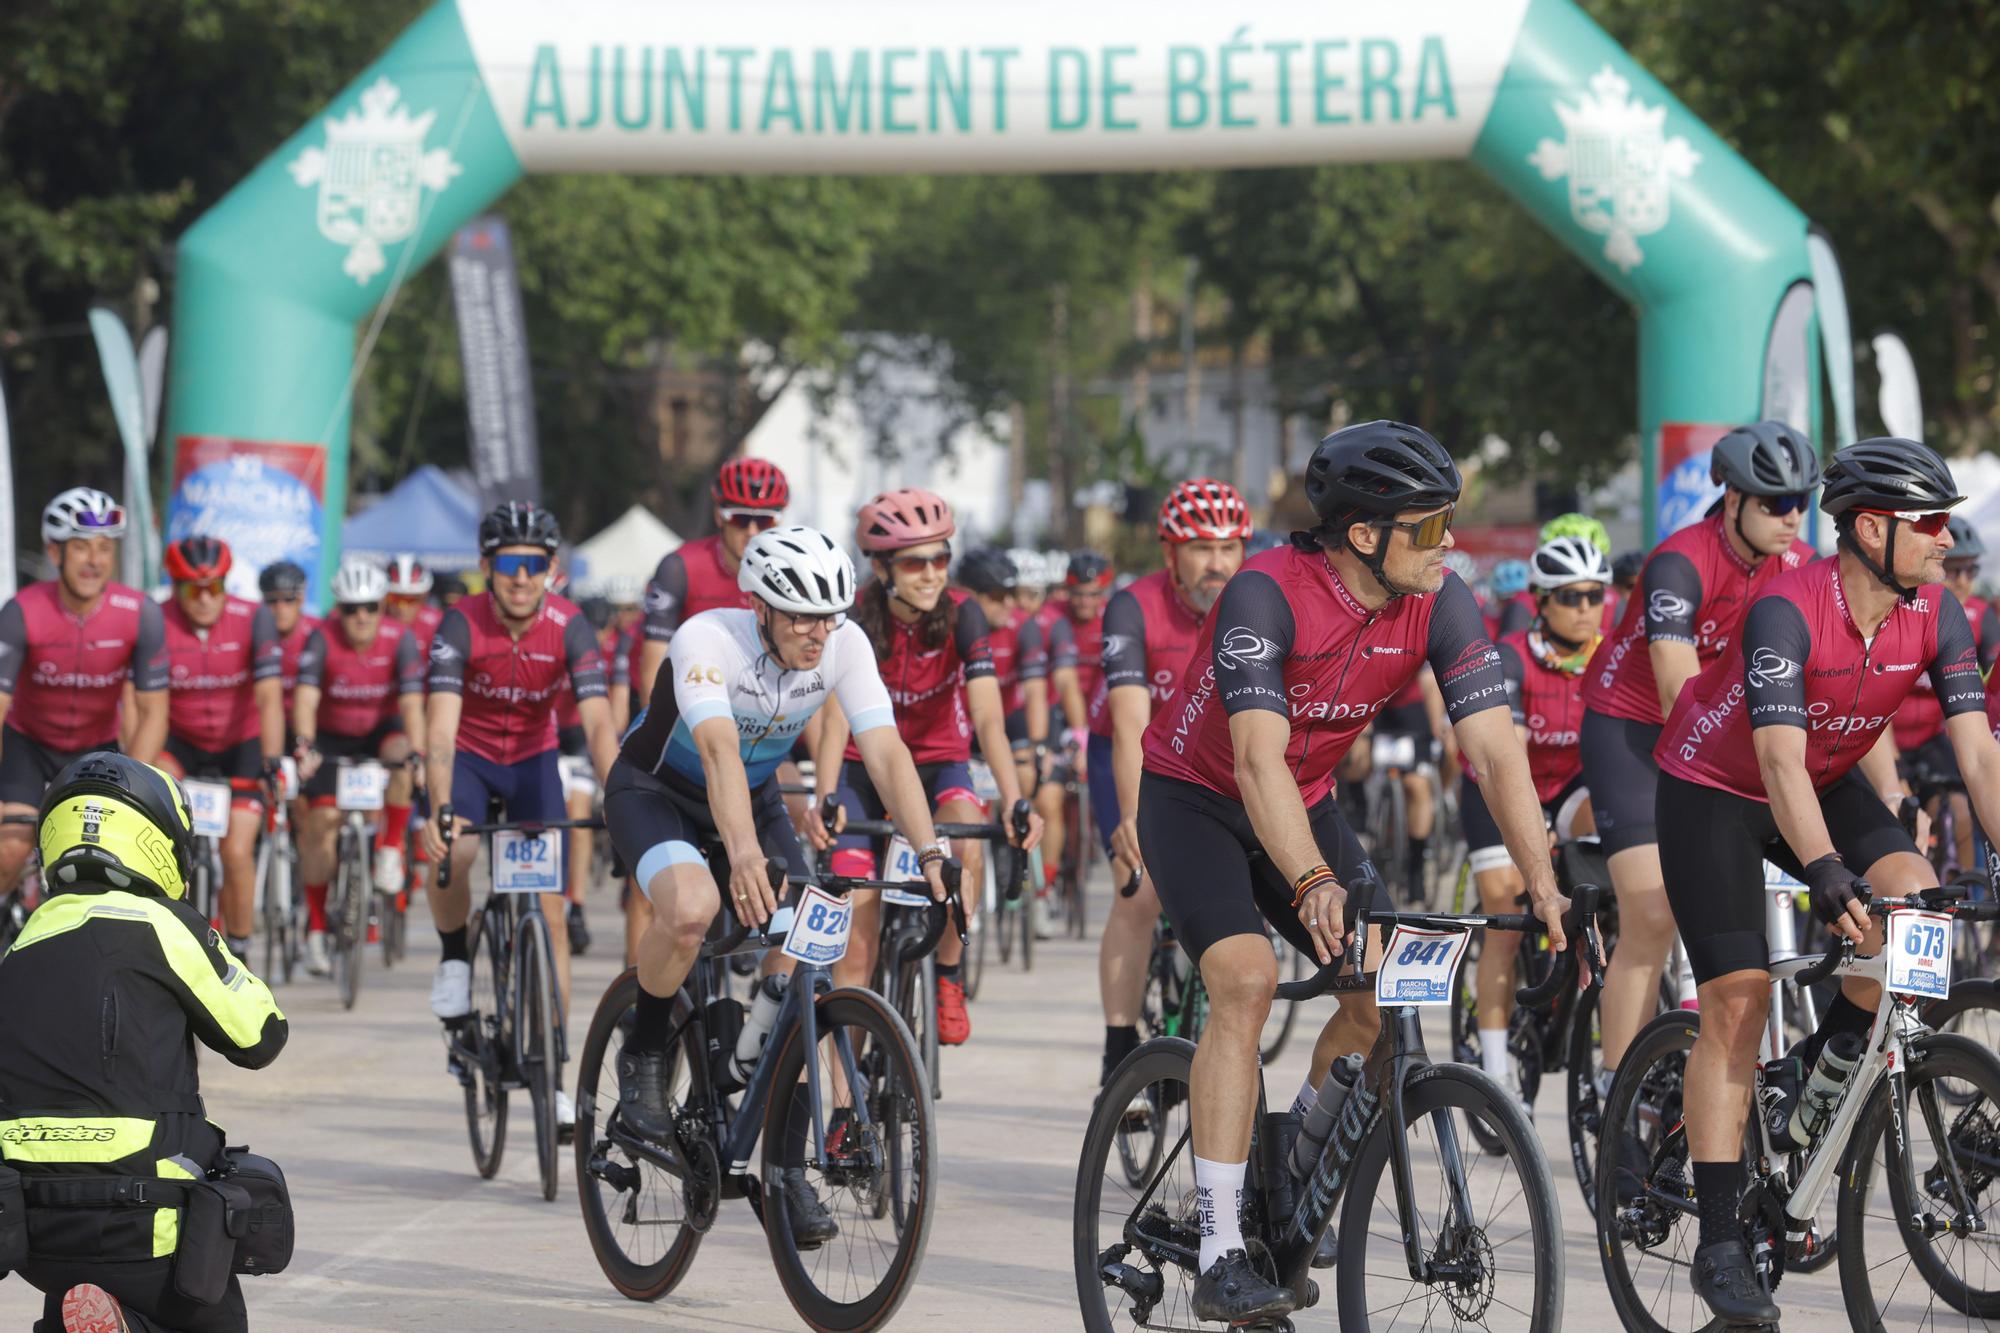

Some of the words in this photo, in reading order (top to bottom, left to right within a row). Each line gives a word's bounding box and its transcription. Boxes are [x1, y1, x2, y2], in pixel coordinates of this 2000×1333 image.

[523, 44, 1020, 134] AJUNTAMENT
[1049, 46, 1139, 132] DE
[1168, 25, 1458, 130] BÉTERA
[1171, 664, 1217, 755] avapace
[1679, 682, 1746, 761] avapace
[72, 804, 116, 817] LS2
[505, 839, 547, 863] 482
[1397, 940, 1454, 966] 841
[1904, 923, 1945, 960] 673
[3, 1124, 116, 1145] alpinestars
[1888, 1078, 1905, 1158] KUOTA
